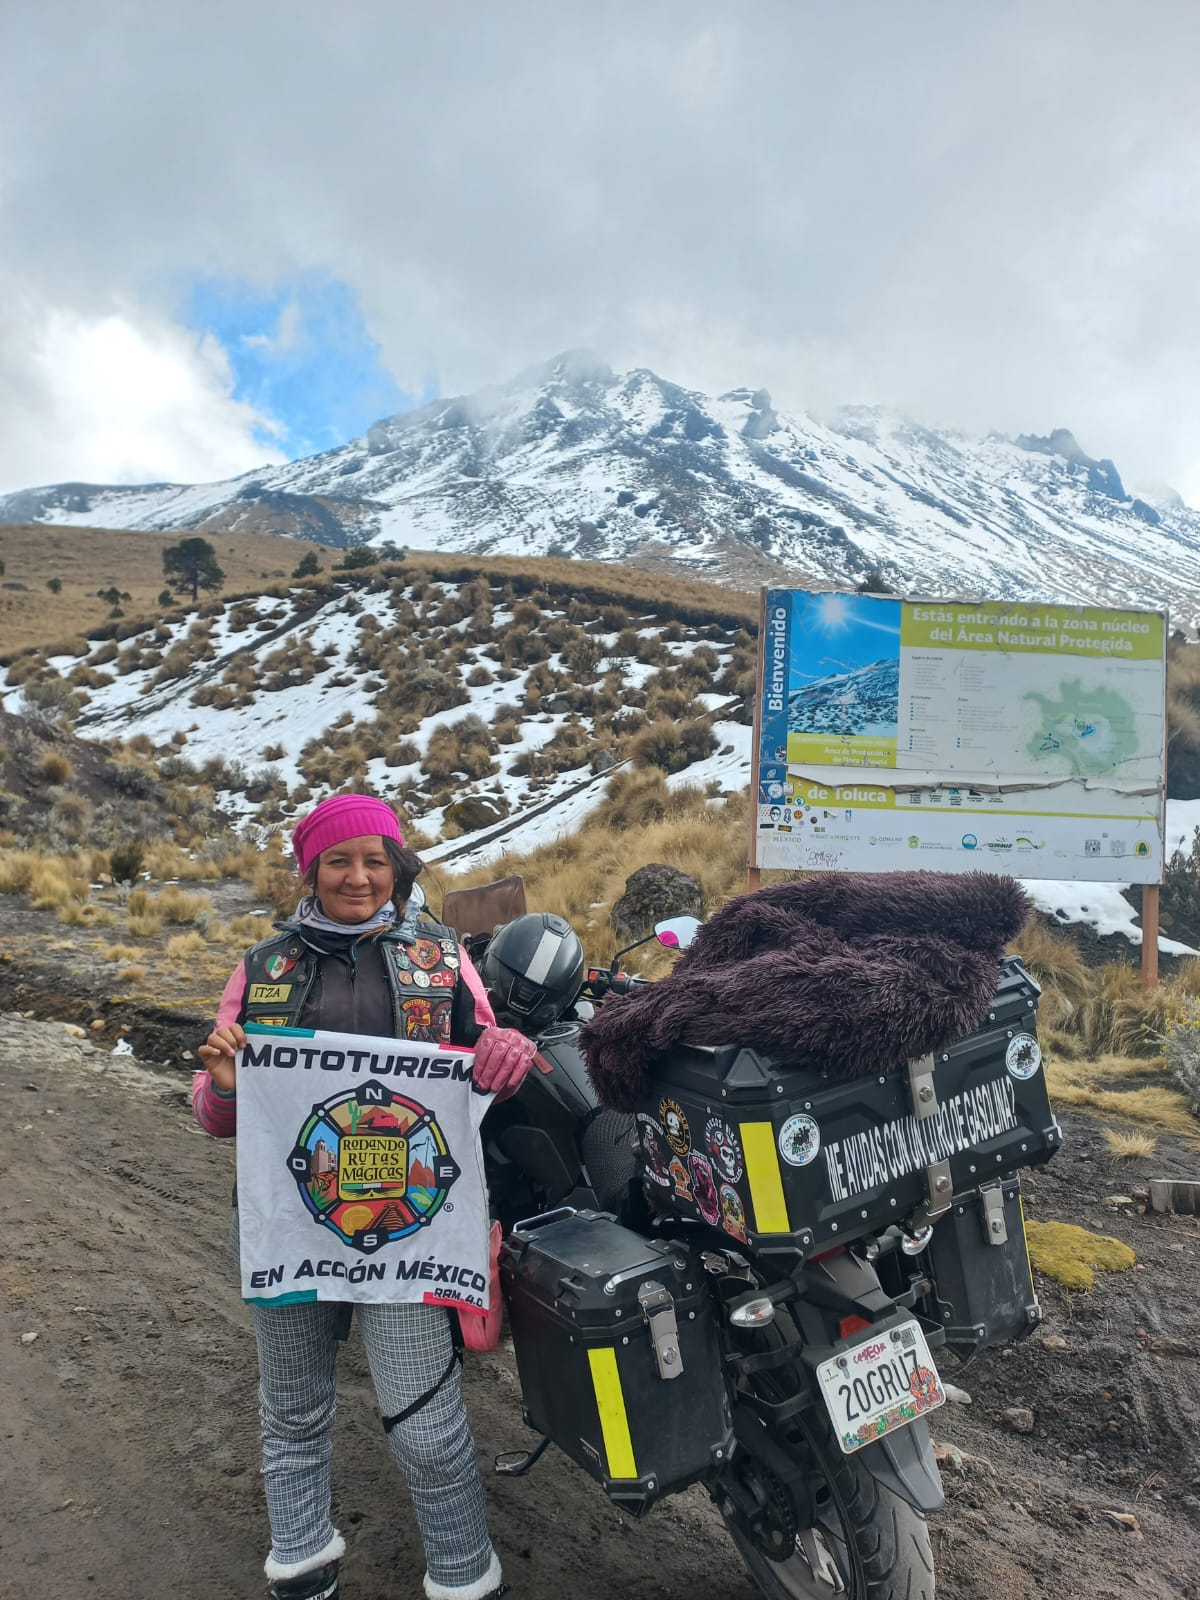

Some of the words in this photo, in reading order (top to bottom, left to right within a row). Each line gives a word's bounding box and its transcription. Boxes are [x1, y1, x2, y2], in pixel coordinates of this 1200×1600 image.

[913, 607, 953, 623] Estás
[957, 613, 1028, 629] entrando
[1031, 618, 1041, 628] a
[1045, 615, 1058, 629] la
[1063, 619, 1098, 631] zona
[1102, 617, 1150, 633] núcleo
[930, 628, 953, 641] del
[957, 626, 993, 643] Área
[997, 631, 1057, 647] Natural
[1060, 632, 1133, 653] Protegida
[768, 608, 787, 711] Bienvenido
[807, 785, 828, 800] de
[834, 786, 887, 802] Toluca
[253, 987, 280, 999] ITZA
[365, 1087, 383, 1100] N
[824, 1143, 849, 1203] ME
[843, 1126, 889, 1194] AYUDAS
[883, 1117, 913, 1179] CON
[949, 1095, 970, 1151] DE
[963, 1075, 1018, 1145] GASOLINA?
[439, 1166, 454, 1178] E
[362, 1234, 378, 1247] S
[250, 1264, 285, 1289] EN
[395, 1255, 487, 1293] MÉXICO
[433, 1287, 462, 1302] RRM
[464, 1293, 483, 1308] 4.0
[838, 1349, 924, 1422] 20GRU7
